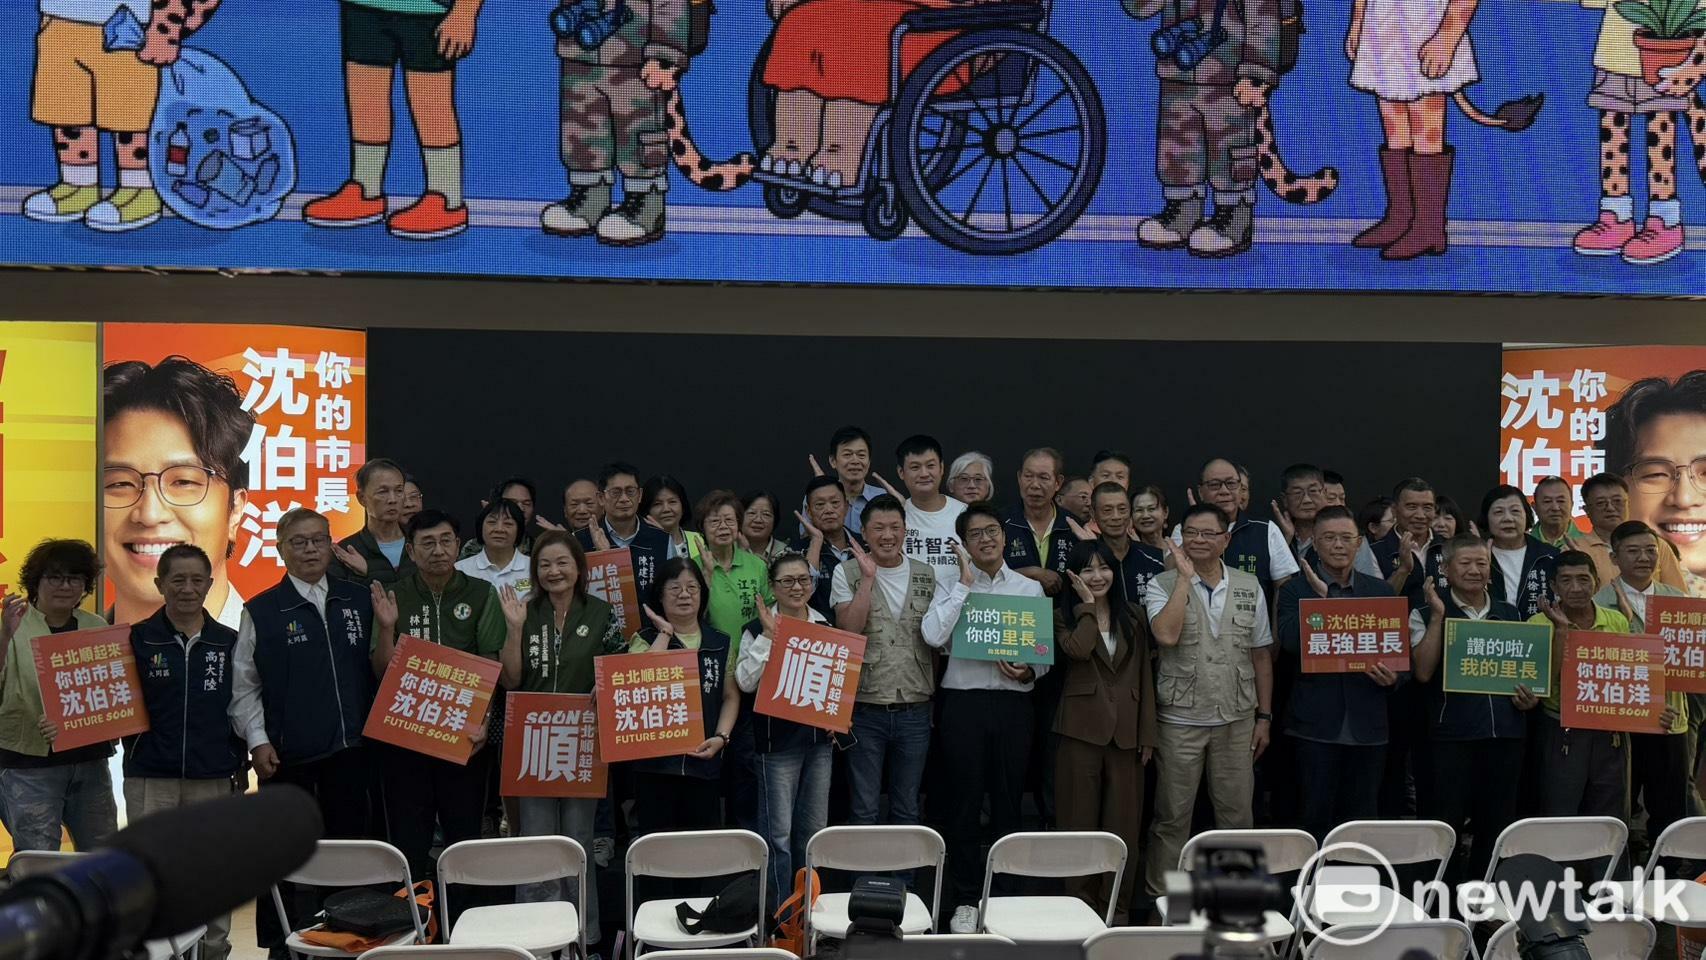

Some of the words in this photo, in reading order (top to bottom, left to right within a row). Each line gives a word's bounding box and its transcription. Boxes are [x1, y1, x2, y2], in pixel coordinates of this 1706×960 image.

[314, 351, 352, 514] 你的市長
[239, 347, 309, 568] 沈伯洋
[1500, 370, 1564, 528] 沈伯
[927, 556, 960, 565] 持續改
[966, 606, 1036, 627] 你的市長
[1327, 614, 1401, 630] 沈伯洋推薦
[1660, 611, 1706, 625] 台北順
[786, 636, 837, 657] SOON
[965, 626, 1037, 647] 你的里長
[1308, 632, 1403, 655] 最強里長
[50, 642, 123, 668] 台北順起來
[1576, 646, 1649, 662] 台北順起來
[55, 660, 126, 690] 你的市長
[406, 655, 481, 687] 台北順起來
[611, 665, 685, 686] 台北順起來
[771, 648, 834, 712] 順
[825, 645, 850, 716] 台北順起來
[1460, 657, 1538, 680] 我的里長
[1576, 662, 1650, 682] 你的市長
[1664, 668, 1696, 678] UTURE
[59, 680, 132, 717] 沈伯洋
[400, 672, 475, 708] 你的市長
[613, 682, 686, 706] 你的市長
[1576, 680, 1650, 706] 沈伯洋
[64, 713, 104, 731] FUTURE
[106, 707, 135, 721] SOON
[389, 690, 468, 731] 沈伯洋
[524, 710, 581, 725] SOON
[615, 702, 689, 732] 沈伯洋
[1575, 704, 1617, 715] FUTURE
[1618, 707, 1650, 718] SOON
[383, 715, 426, 734] FUTURE
[427, 728, 460, 744] SOON
[615, 732, 656, 745] FUTURE
[658, 728, 689, 739] SOON
[516, 725, 579, 783] 順
[578, 710, 595, 783] 台北順起來
